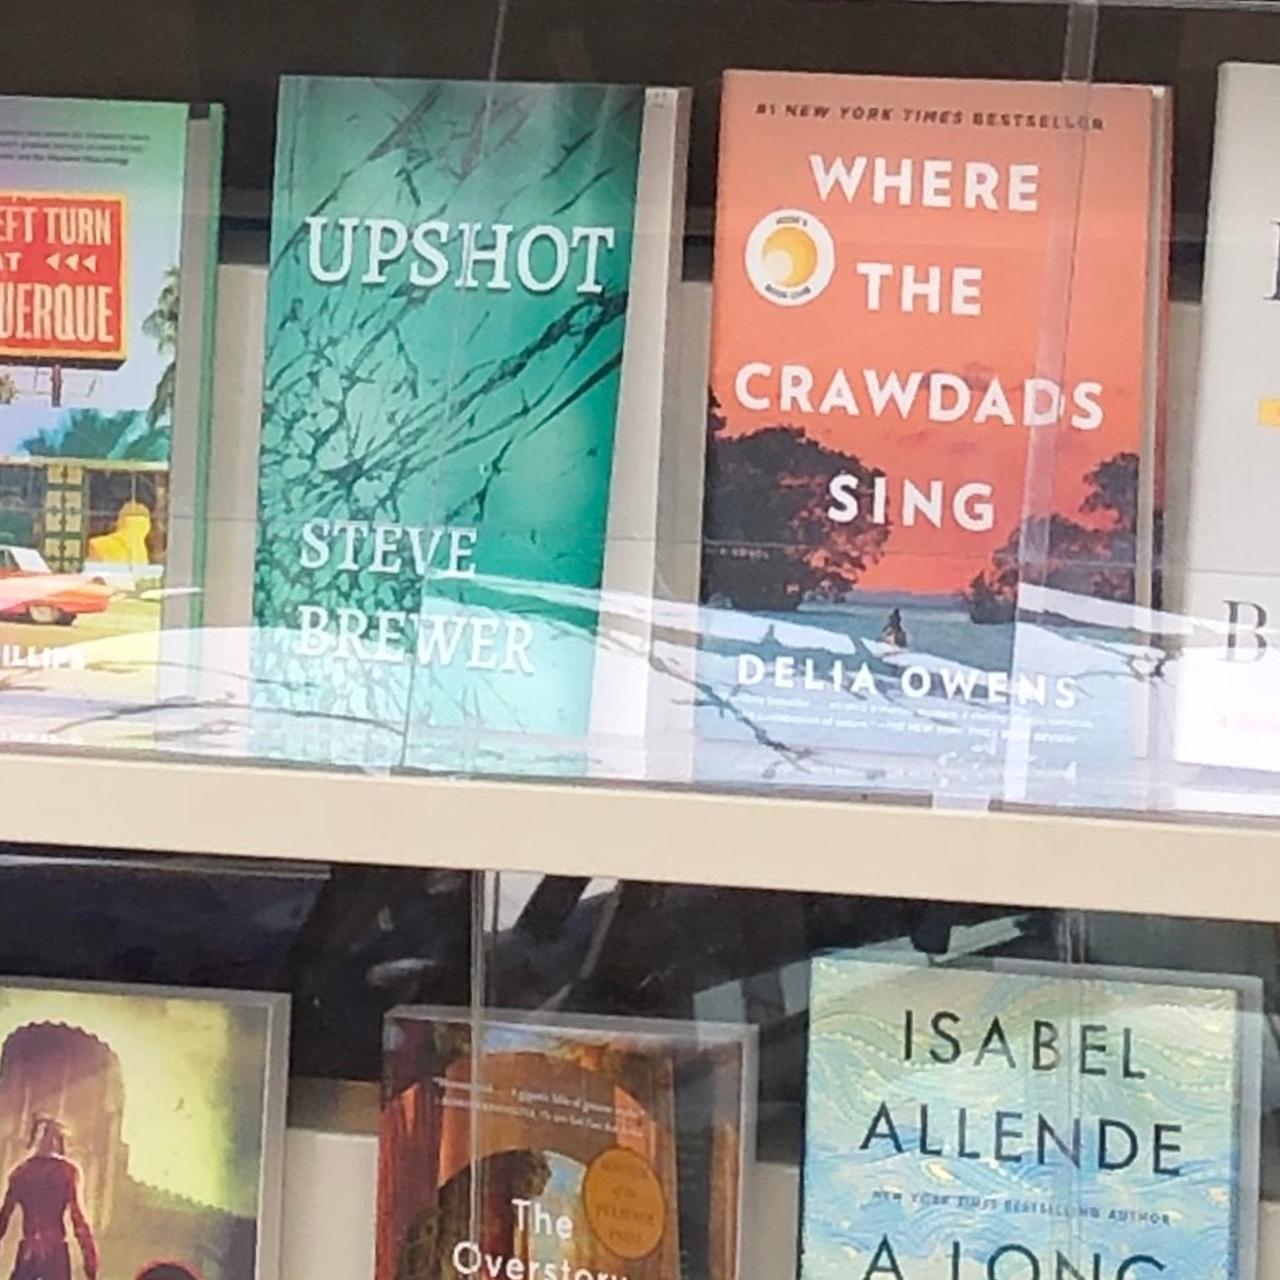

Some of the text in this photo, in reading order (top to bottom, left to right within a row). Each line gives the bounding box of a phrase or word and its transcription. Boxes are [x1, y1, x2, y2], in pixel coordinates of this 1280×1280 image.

[755, 101, 1106, 132] #1 NEW YORK TIMES BESTSELLER
[808, 152, 1041, 212] WHERE
[45, 205, 113, 246] TURN
[304, 214, 617, 296] UPSHOT
[856, 261, 984, 316] THE
[732, 361, 1106, 431] CRAWDADS
[825, 471, 997, 532] SING
[298, 517, 478, 579] STEVE
[294, 604, 536, 675] BREWER
[735, 652, 1080, 709] DELIA OWENS
[903, 1009, 1148, 1080] ISABEL
[858, 1101, 1184, 1177] ALLENDE
[512, 1198, 574, 1239] The
[909, 1193, 951, 1207] YORK
[1107, 1208, 1172, 1226] AUTHOR
[862, 1233, 903, 1280] A
